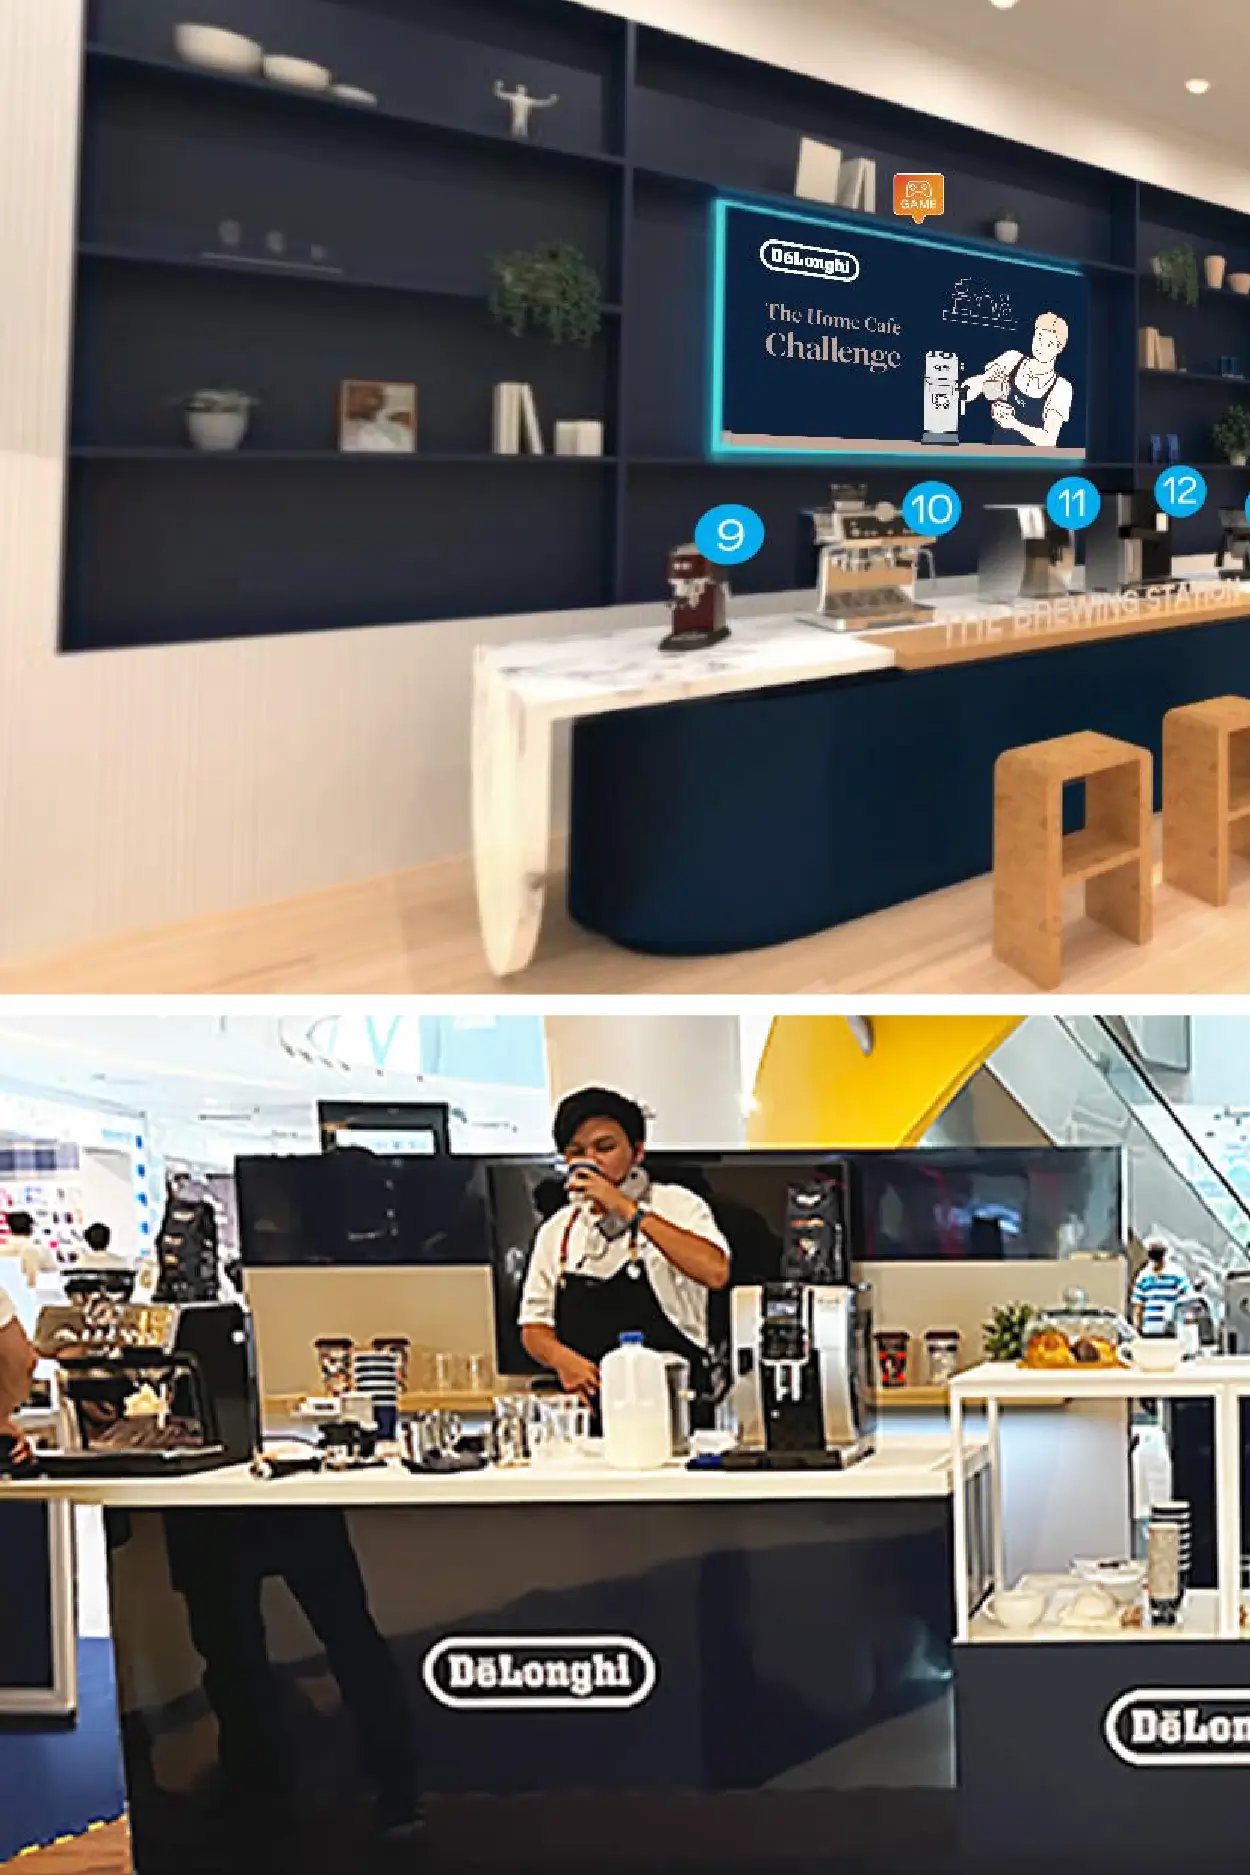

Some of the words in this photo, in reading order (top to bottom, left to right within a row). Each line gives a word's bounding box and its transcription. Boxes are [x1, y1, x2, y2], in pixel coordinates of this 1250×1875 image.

[765, 303, 803, 324] The
[807, 308, 860, 330] Home
[765, 331, 901, 373] Challenge
[940, 606, 1003, 648] THE
[1013, 587, 1139, 637] BREWING
[1146, 577, 1241, 613] STATION
